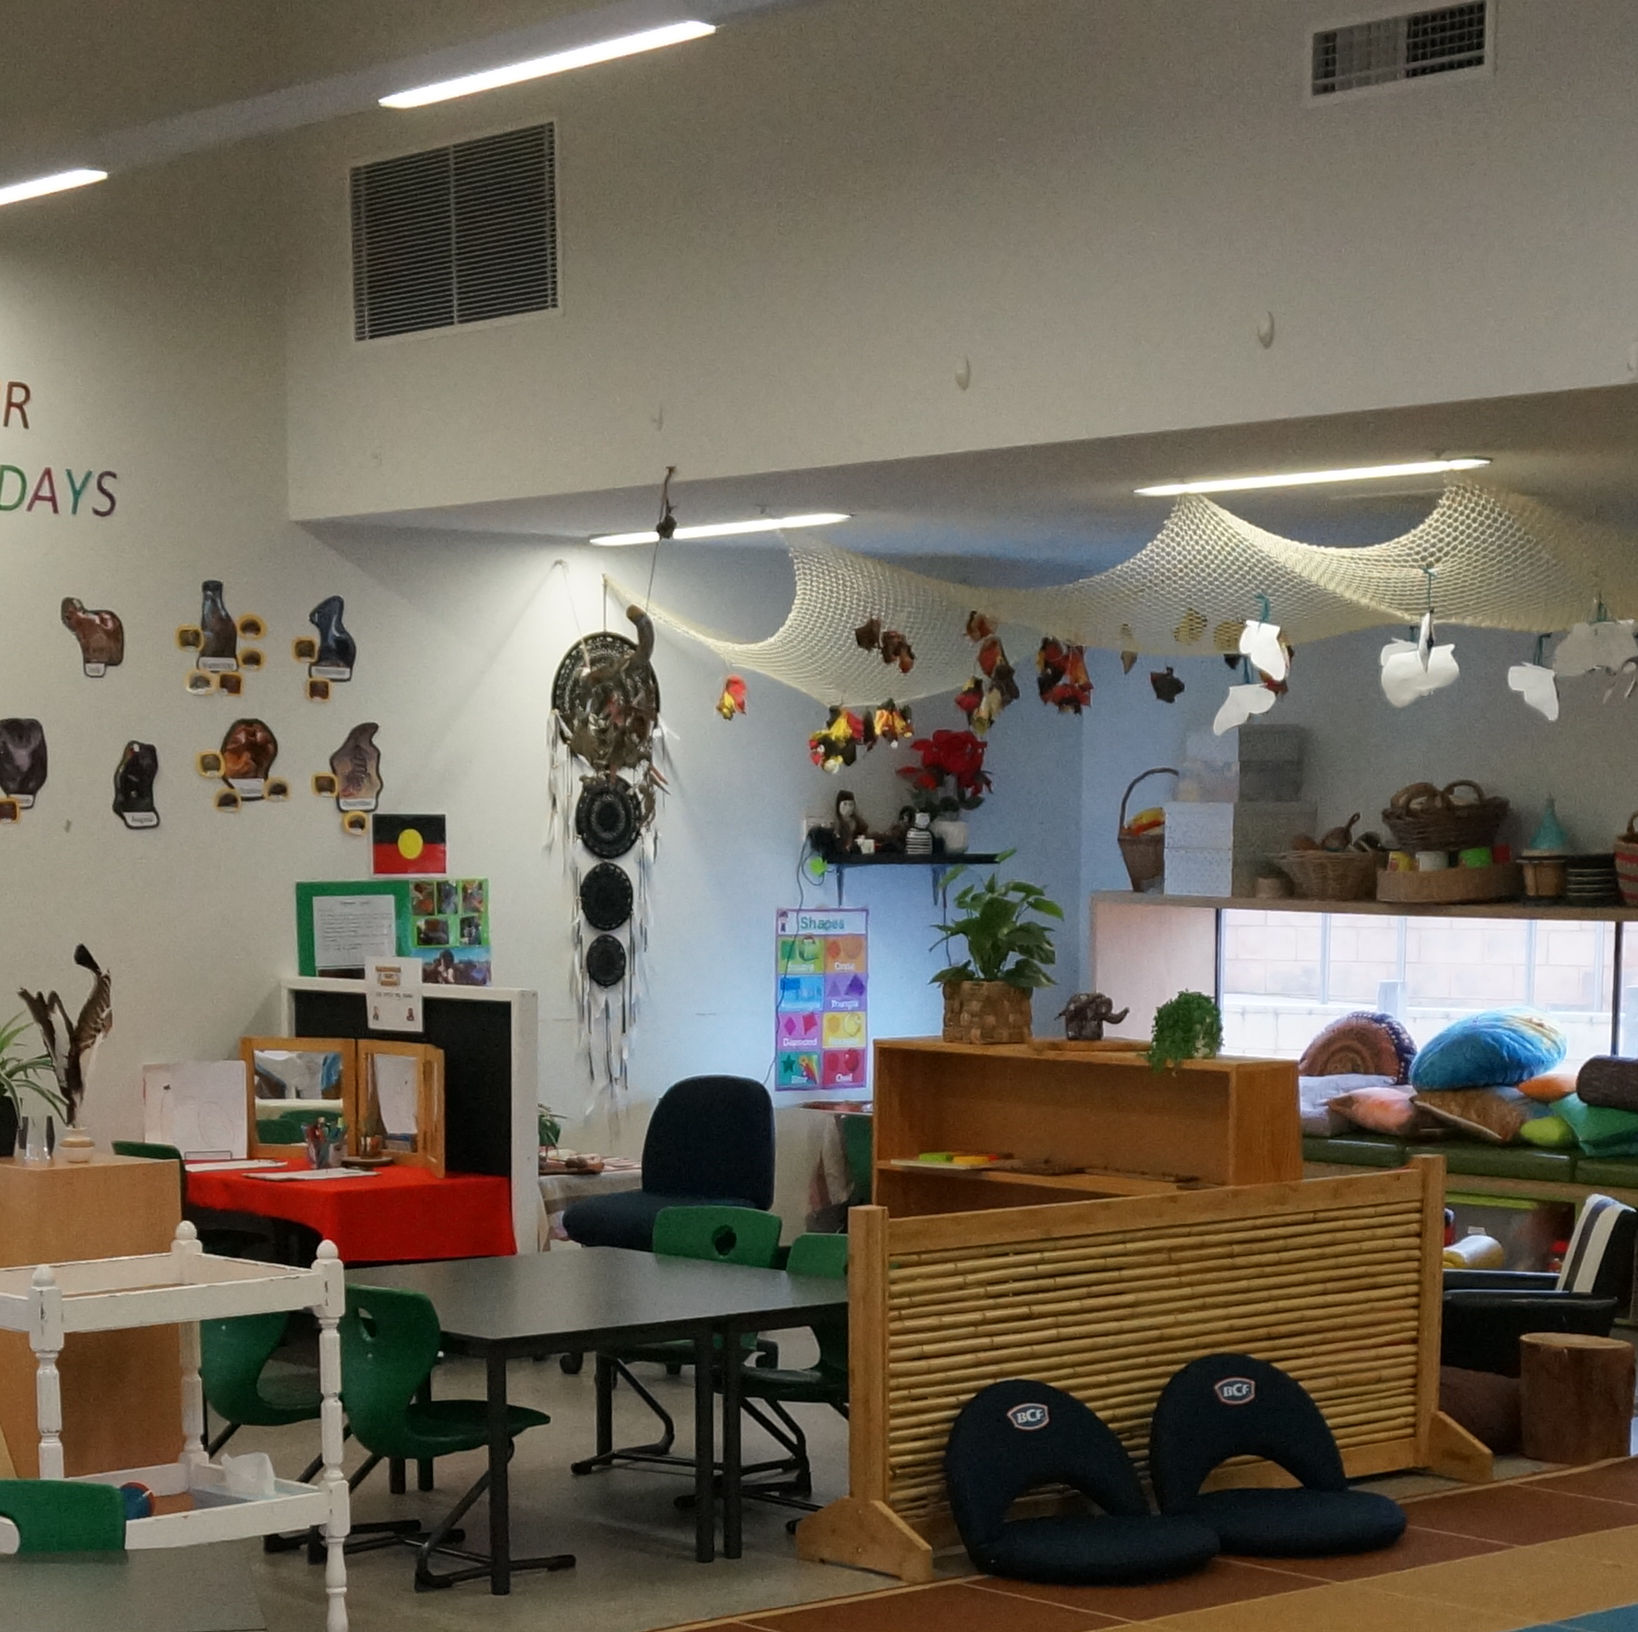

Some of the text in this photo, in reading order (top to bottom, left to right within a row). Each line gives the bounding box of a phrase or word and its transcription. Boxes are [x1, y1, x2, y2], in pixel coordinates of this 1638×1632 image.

[800, 916, 845, 931] Shapes
[1223, 1383, 1250, 1397] BCF
[1016, 1408, 1044, 1423] BCF
